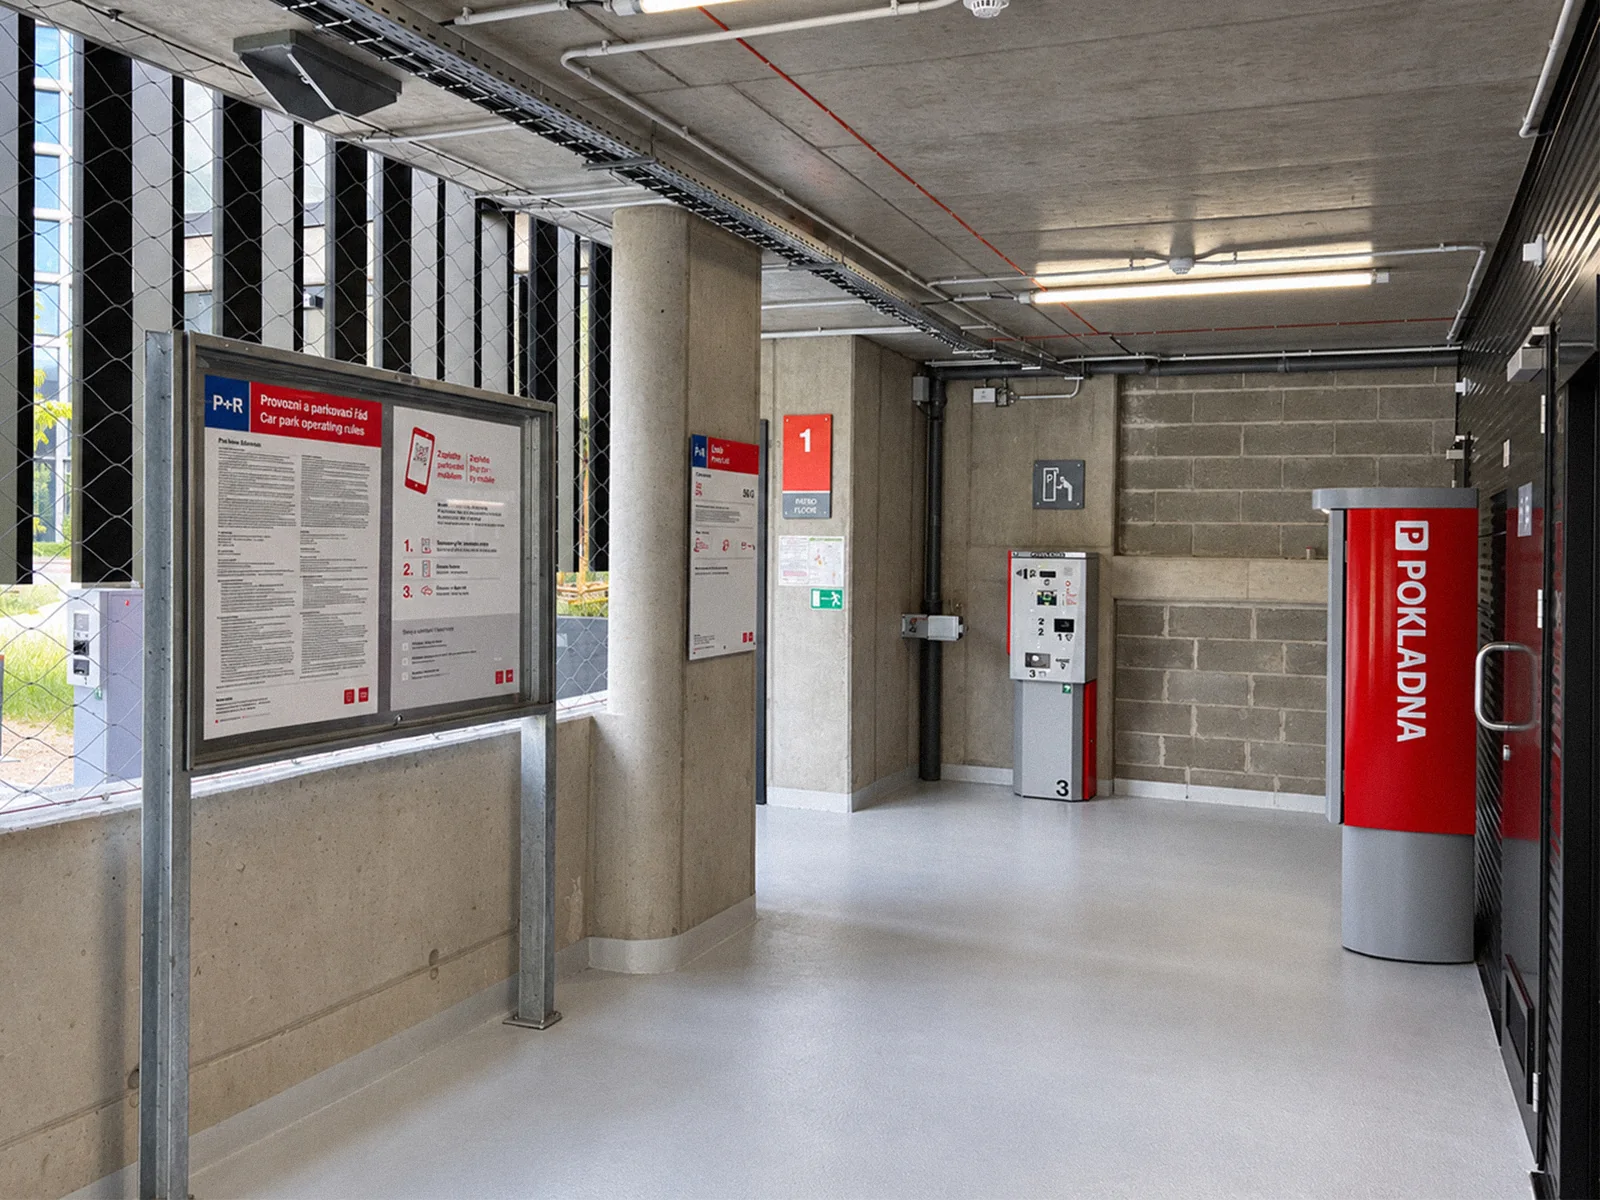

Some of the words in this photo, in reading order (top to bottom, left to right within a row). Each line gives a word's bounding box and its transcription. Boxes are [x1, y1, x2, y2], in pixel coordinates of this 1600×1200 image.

[212, 394, 243, 414] P+R
[303, 403, 310, 412] a
[260, 411, 277, 424] Car
[279, 415, 300, 428] park
[301, 419, 343, 436] operating
[344, 424, 365, 436] rules
[799, 428, 811, 453] 1
[404, 538, 414, 553] 1.
[402, 562, 414, 577] 2.
[402, 584, 413, 599] 3.
[1396, 560, 1427, 743] POKLADNA
[1055, 779, 1070, 797] 3
